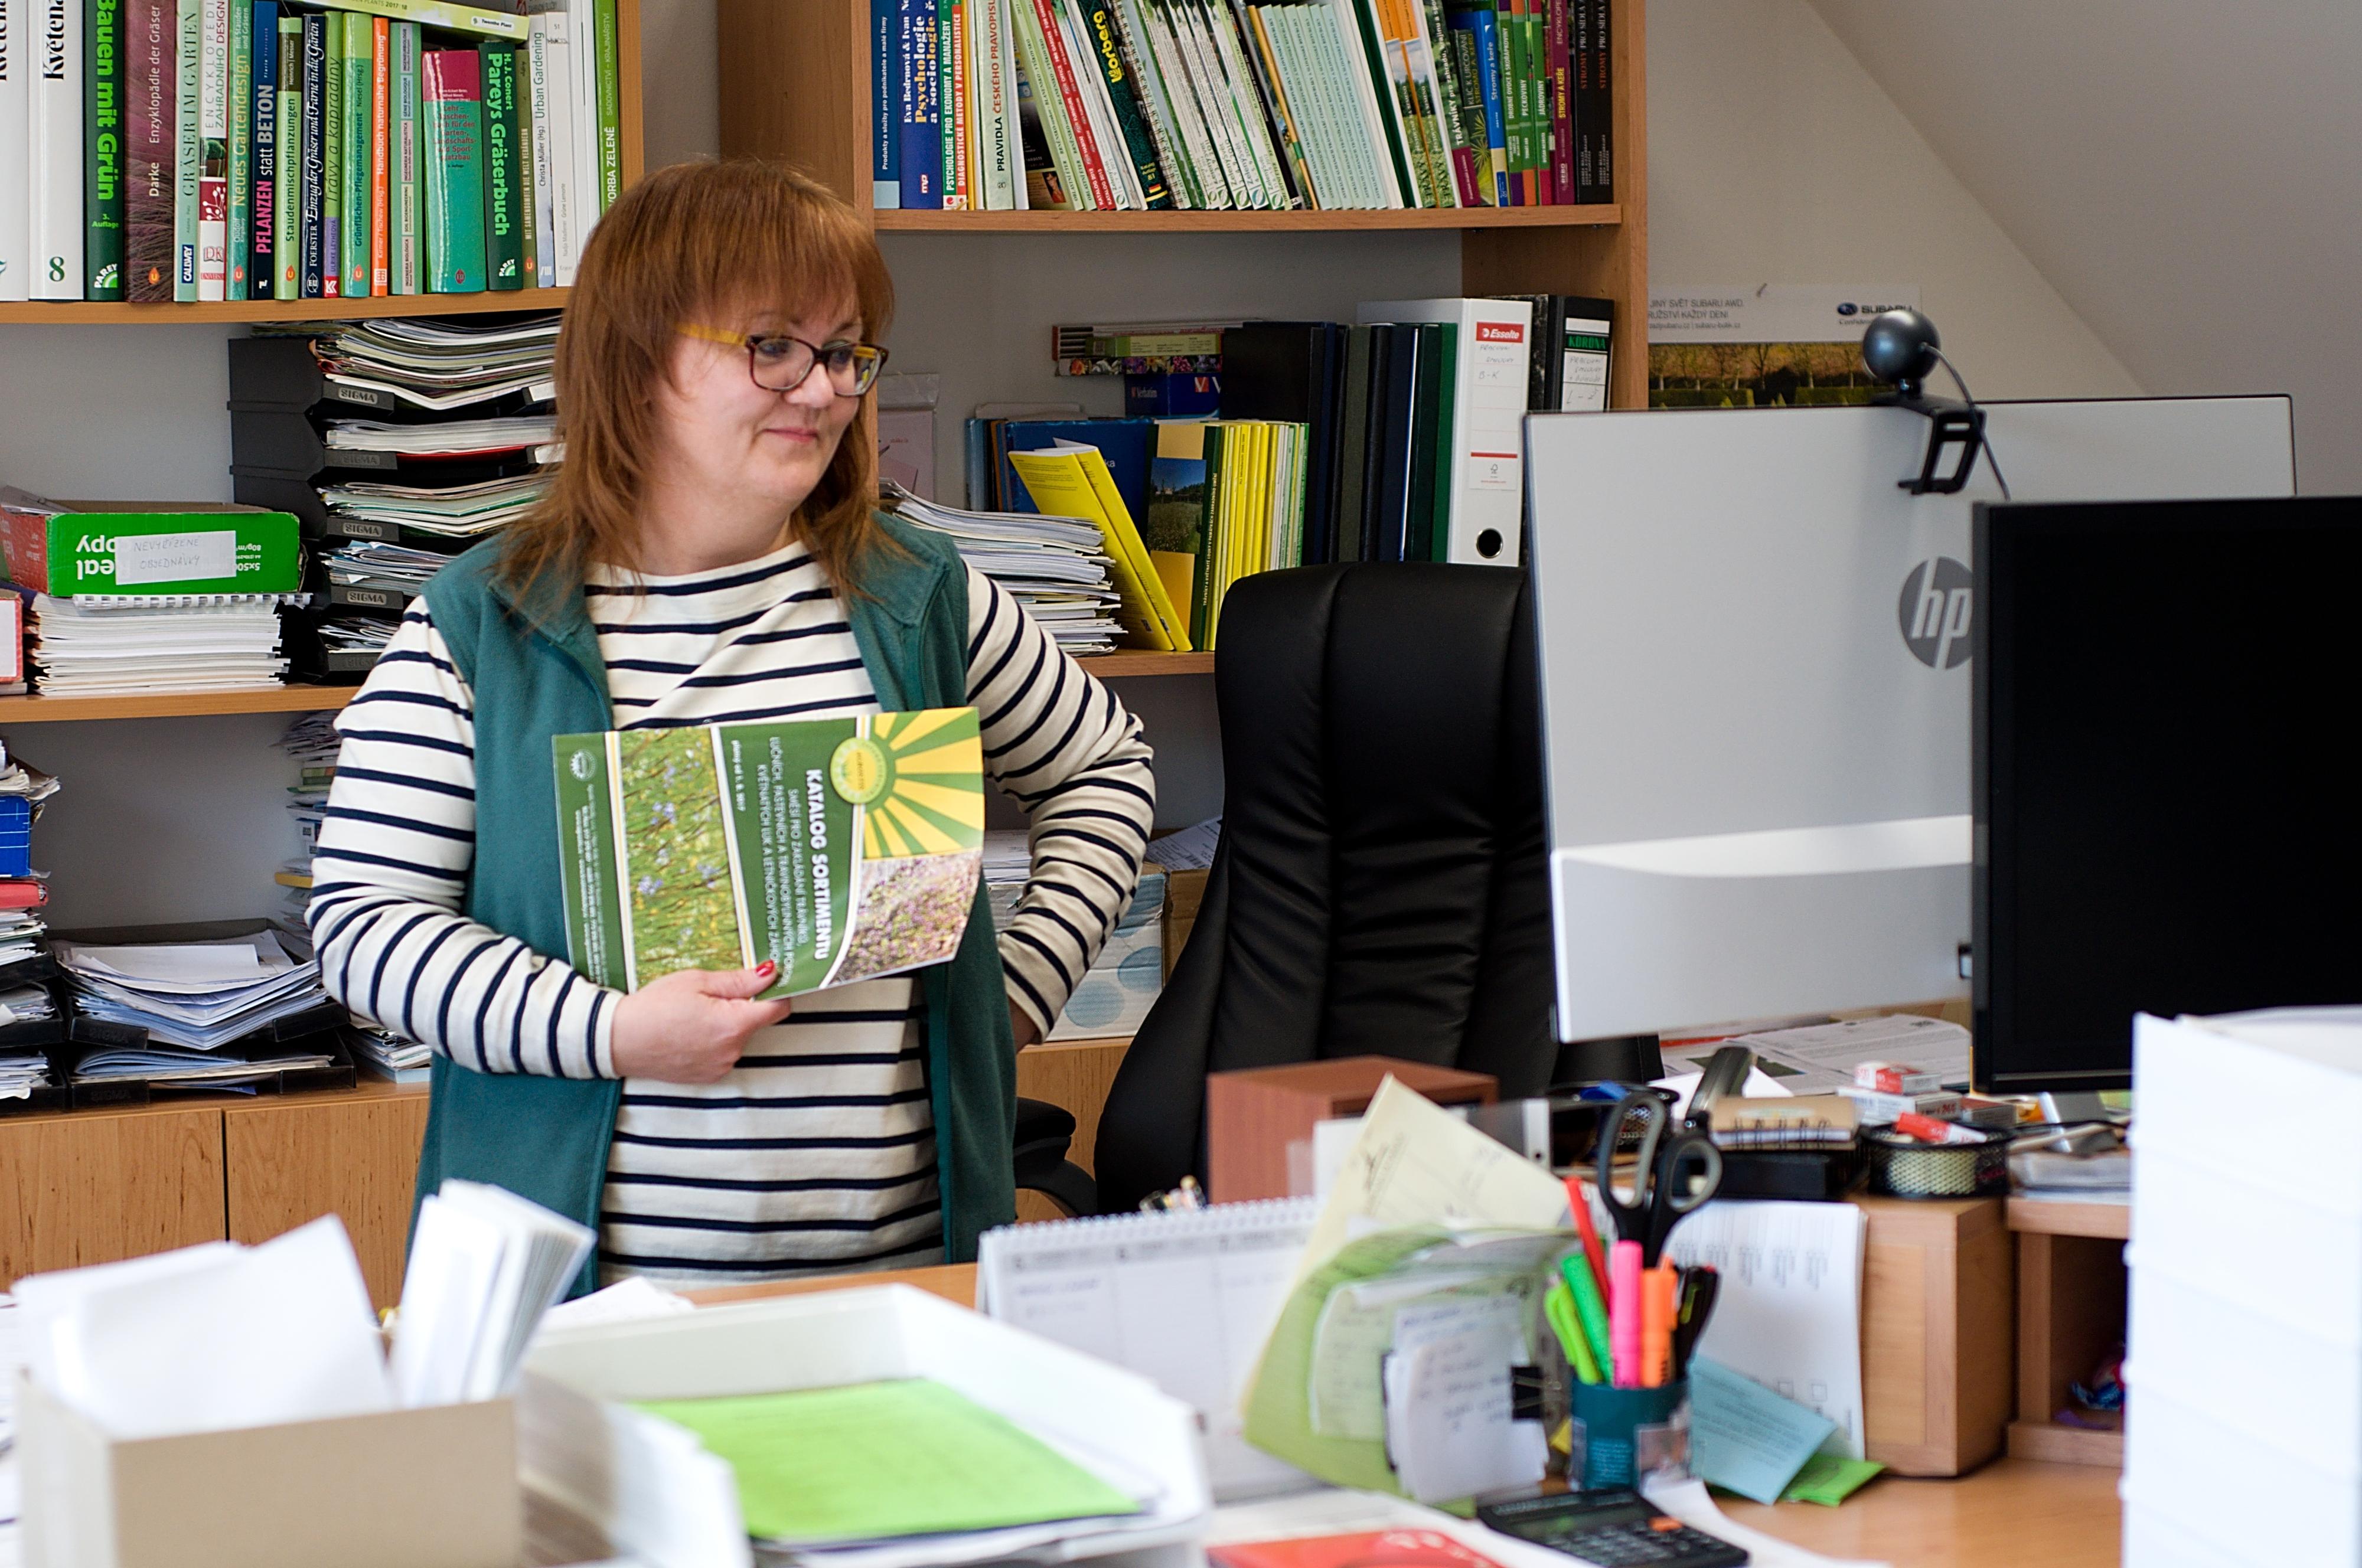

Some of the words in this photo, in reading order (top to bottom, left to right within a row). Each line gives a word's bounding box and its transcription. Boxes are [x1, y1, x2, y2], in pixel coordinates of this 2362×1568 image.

[97, 0, 114, 76] Bauen
[149, 6, 159, 42] Gräser
[216, 1, 224, 43] DESIGN
[901, 16, 910, 38] Ivan
[149, 46, 159, 64] der
[183, 12, 197, 85] GARTEN
[308, 22, 324, 59] Gärten
[376, 35, 386, 82] Begrünung
[503, 53, 511, 64] H.
[531, 32, 546, 85] Gardening
[902, 42, 910, 51] &
[941, 20, 951, 64] MANAŽERY
[953, 14, 962, 80] PERSONALISTICE
[1093, 10, 1125, 83] Lorberg
[1486, 41, 1494, 60] keře
[308, 58, 318, 71] die
[308, 72, 318, 81] in
[503, 66, 511, 74] J.
[901, 54, 911, 101] Bedrnová
[912, 15, 929, 123] Psychologie
[925, 16, 939, 105] sociologie
[1556, 67, 1564, 84] KEŘE
[1579, 51, 1588, 89] STROMY
[1598, 51, 1607, 89] STROMY
[214, 47, 224, 128] ZAHRADNÍHO
[306, 83, 319, 115] Farne
[325, 57, 342, 138] kapradiny
[485, 53, 504, 119] Pareys
[503, 76, 514, 110] Conert
[943, 75, 952, 114] EKONOMY
[990, 62, 1001, 113] ČESKÉHO
[1488, 68, 1499, 100] Stromy
[1519, 79, 1529, 116] PECKOVINY
[1535, 79, 1546, 115] JÁDROVINY
[97, 83, 116, 126] mit
[149, 67, 161, 143] Enzyklopädie
[184, 94, 196, 113] IM
[232, 55, 249, 155] Gartendesign
[257, 84, 273, 143] BETON
[376, 83, 384, 129] naturnahe
[533, 87, 545, 118] Urban
[903, 104, 912, 123] Eva
[931, 112, 938, 123] a
[955, 90, 963, 125] METODY
[1558, 92, 1567, 117] STROMY
[307, 116, 318, 135] und
[944, 117, 953, 133] PRO
[1447, 99, 1464, 145] TRÁVNÍKY
[180, 123, 196, 196] GRÄSER
[258, 148, 273, 175] statt
[306, 136, 322, 172] Gräser
[329, 146, 338, 154] a
[376, 131, 384, 174] Handbuch
[536, 142, 545, 162] Müller
[605, 126, 617, 166] ZELENĚ
[954, 126, 965, 186] DIAGNOSTICKÉ
[994, 116, 1004, 171] PRAVIDLA
[97, 133, 117, 199] Grün
[149, 162, 159, 196] Darke
[285, 99, 297, 241] Staudenmischpflanzungen
[306, 171, 317, 184] der
[324, 160, 340, 202] Trávy
[353, 113, 364, 246] Grünflächen-Pflegemanagement
[489, 123, 511, 236] Gräserbuch
[537, 164, 547, 186] Christa
[944, 136, 954, 190] PSYCHOLOGIE
[231, 159, 246, 206] Neues
[1092, 180, 1104, 205] KATALOG
[255, 180, 272, 253] PFLANZEN
[305, 185, 321, 220] Einzug
[309, 225, 318, 266] FOERSTER
[49, 256, 65, 282] 8
[94, 263, 118, 288] PAREY
[184, 246, 193, 282] CALLWEY
[499, 259, 514, 276] PAREY
[1490, 328, 1520, 339] Esselte
[1568, 335, 1606, 349] KORONA
[340, 387, 376, 403] SIGMA
[76, 535, 116, 553] opy
[345, 523, 379, 535] SIGMA
[76, 559, 115, 580] eal
[348, 591, 384, 604] SIGMA
[1911, 557, 1973, 669] hp
[805, 769, 827, 850] KATALOG
[761, 827, 772, 845] LUK
[789, 819, 801, 839] PRO
[762, 846, 772, 855] A
[808, 854, 833, 959] SORTIMENTU
